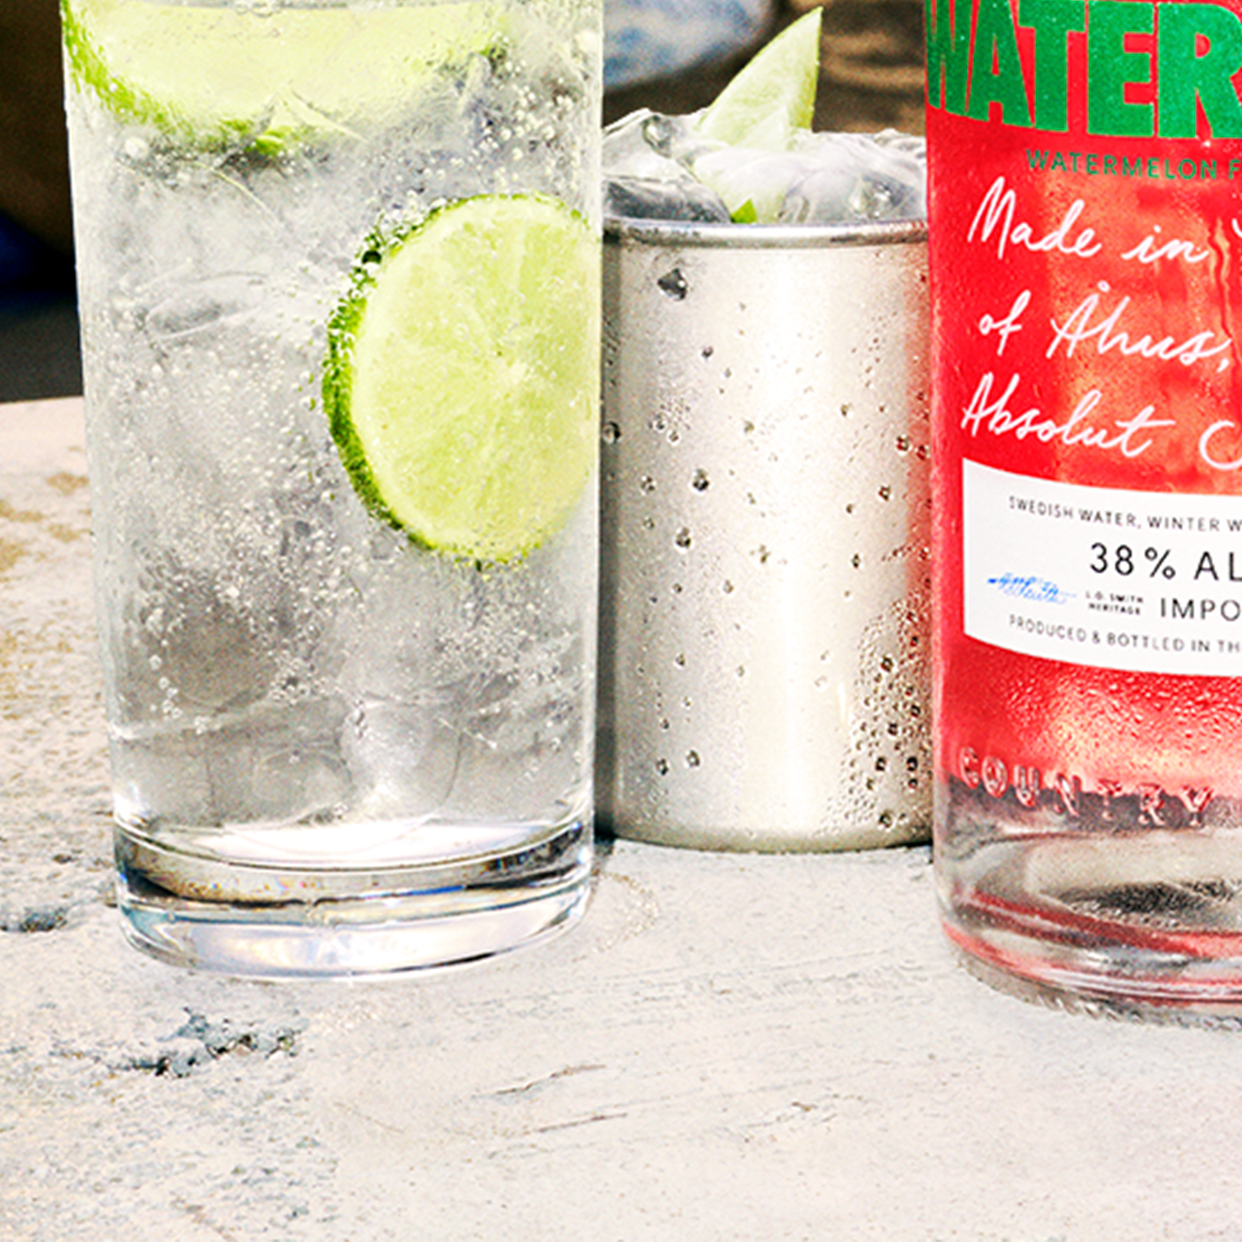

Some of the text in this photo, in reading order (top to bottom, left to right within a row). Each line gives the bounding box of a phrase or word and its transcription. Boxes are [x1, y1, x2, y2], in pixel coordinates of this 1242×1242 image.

[1028, 151, 1216, 179] WATERMELON
[967, 176, 1103, 260] Made
[1121, 225, 1208, 263] in
[979, 290, 1032, 356] of
[1045, 279, 1233, 374] Åhus,
[960, 372, 1176, 455] Absolut
[1009, 496, 1073, 518] SWEDISH
[1079, 509, 1143, 529] WATER,
[1147, 516, 1220, 531] WINTER
[1089, 541, 1177, 581] 38%
[1010, 614, 1085, 642] PRODUCED
[1092, 631, 1101, 644] &
[1107, 632, 1185, 652] BOTTLED
[1191, 640, 1210, 652] IN
[959, 747, 1214, 828] COUNTRY
